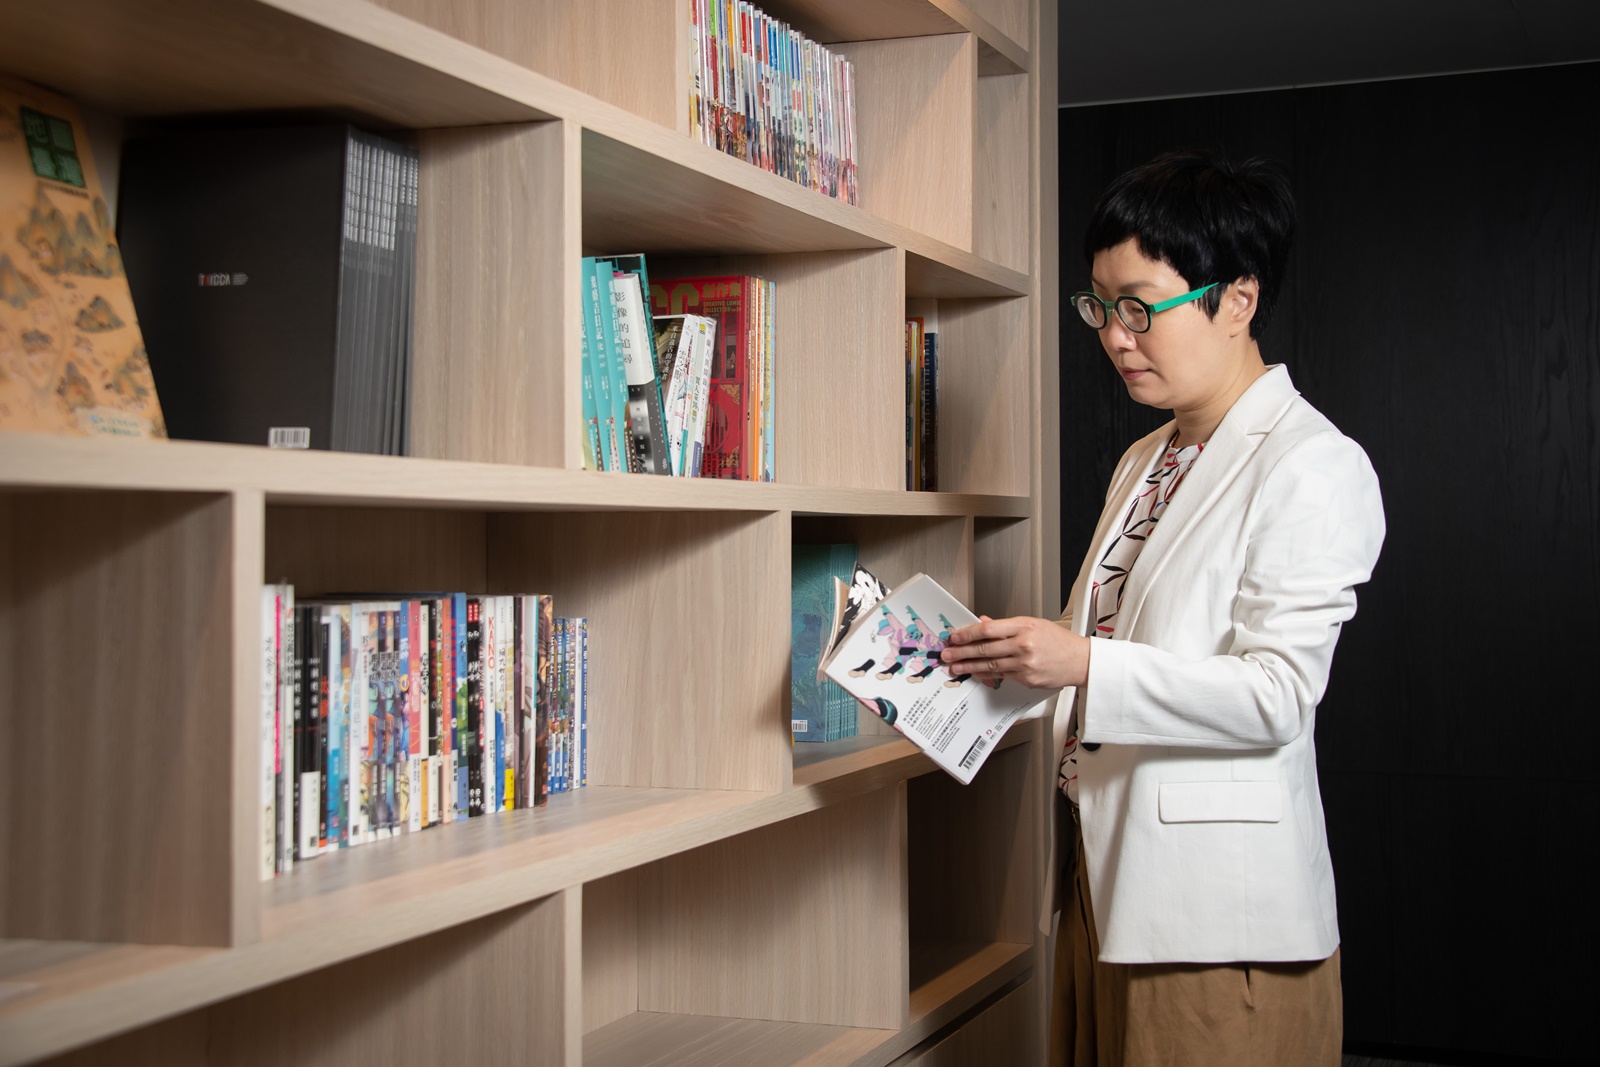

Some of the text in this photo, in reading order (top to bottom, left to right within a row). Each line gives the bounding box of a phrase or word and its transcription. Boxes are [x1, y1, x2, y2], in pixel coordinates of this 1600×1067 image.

[702, 281, 742, 299] 創作集
[615, 291, 633, 364] 影像的追尋
[487, 616, 496, 670] KANO
